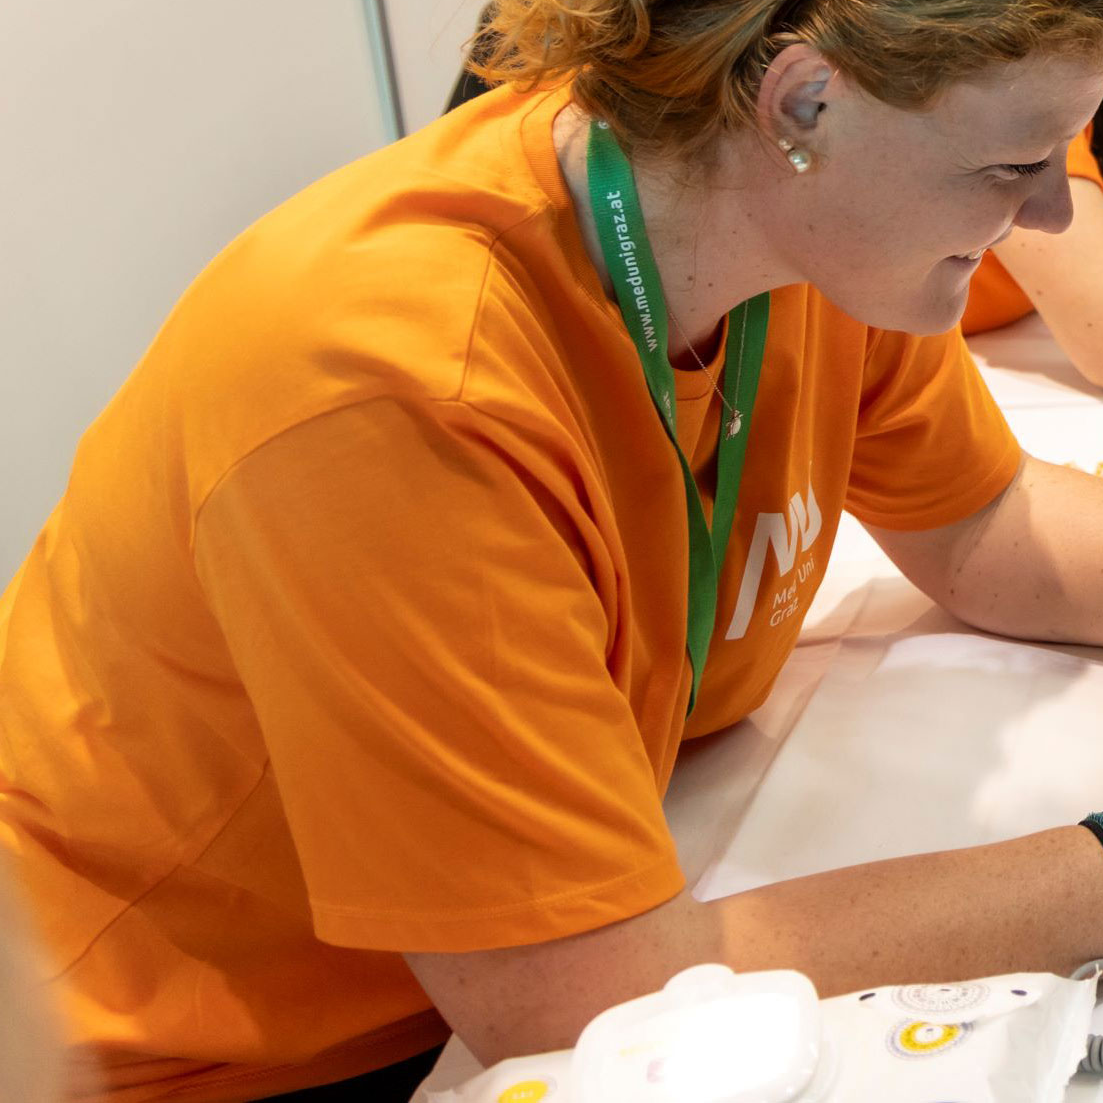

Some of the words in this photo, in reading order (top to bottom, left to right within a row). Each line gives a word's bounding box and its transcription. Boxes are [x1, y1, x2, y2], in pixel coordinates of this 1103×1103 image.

[606, 189, 658, 353] www.medunigraz.at
[798, 552, 815, 583] Uni
[770, 597, 799, 627] Graz
